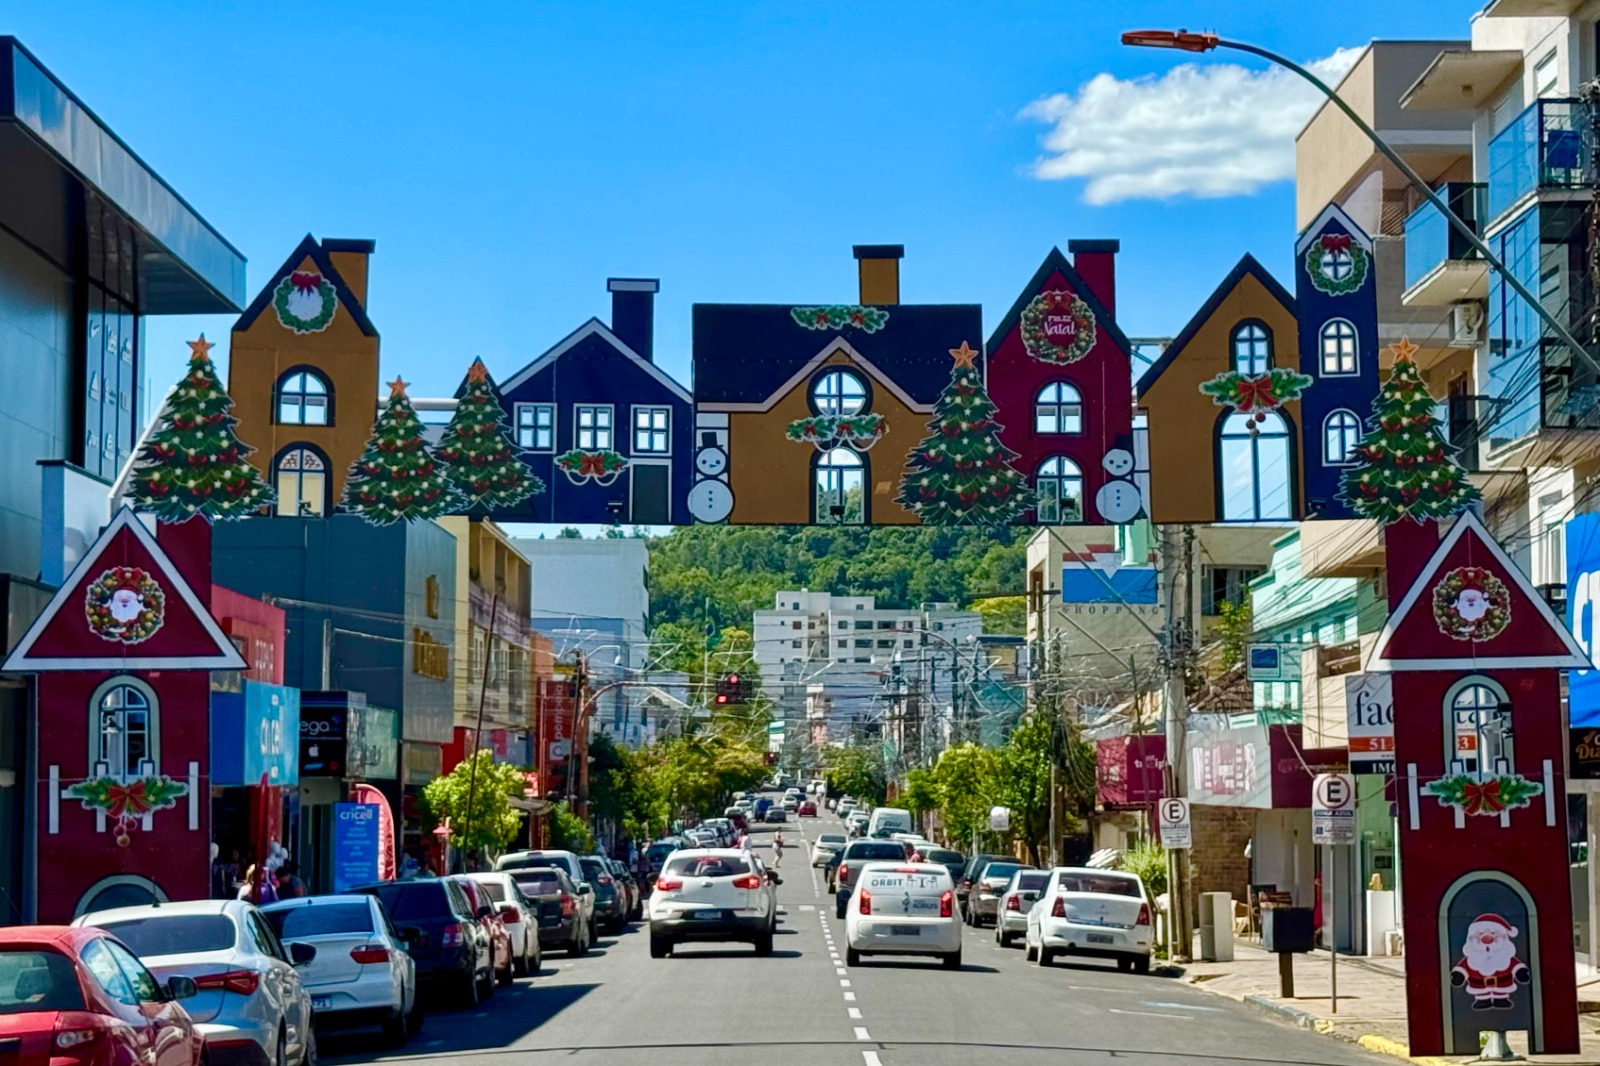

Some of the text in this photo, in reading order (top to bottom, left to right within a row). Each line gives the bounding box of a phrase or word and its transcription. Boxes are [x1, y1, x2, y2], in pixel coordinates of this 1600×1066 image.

[1044, 321, 1076, 336] Natal
[1327, 781, 1342, 802] E
[340, 808, 373, 820] cricell
[1169, 803, 1180, 820] E
[871, 879, 904, 887] ORBIT
